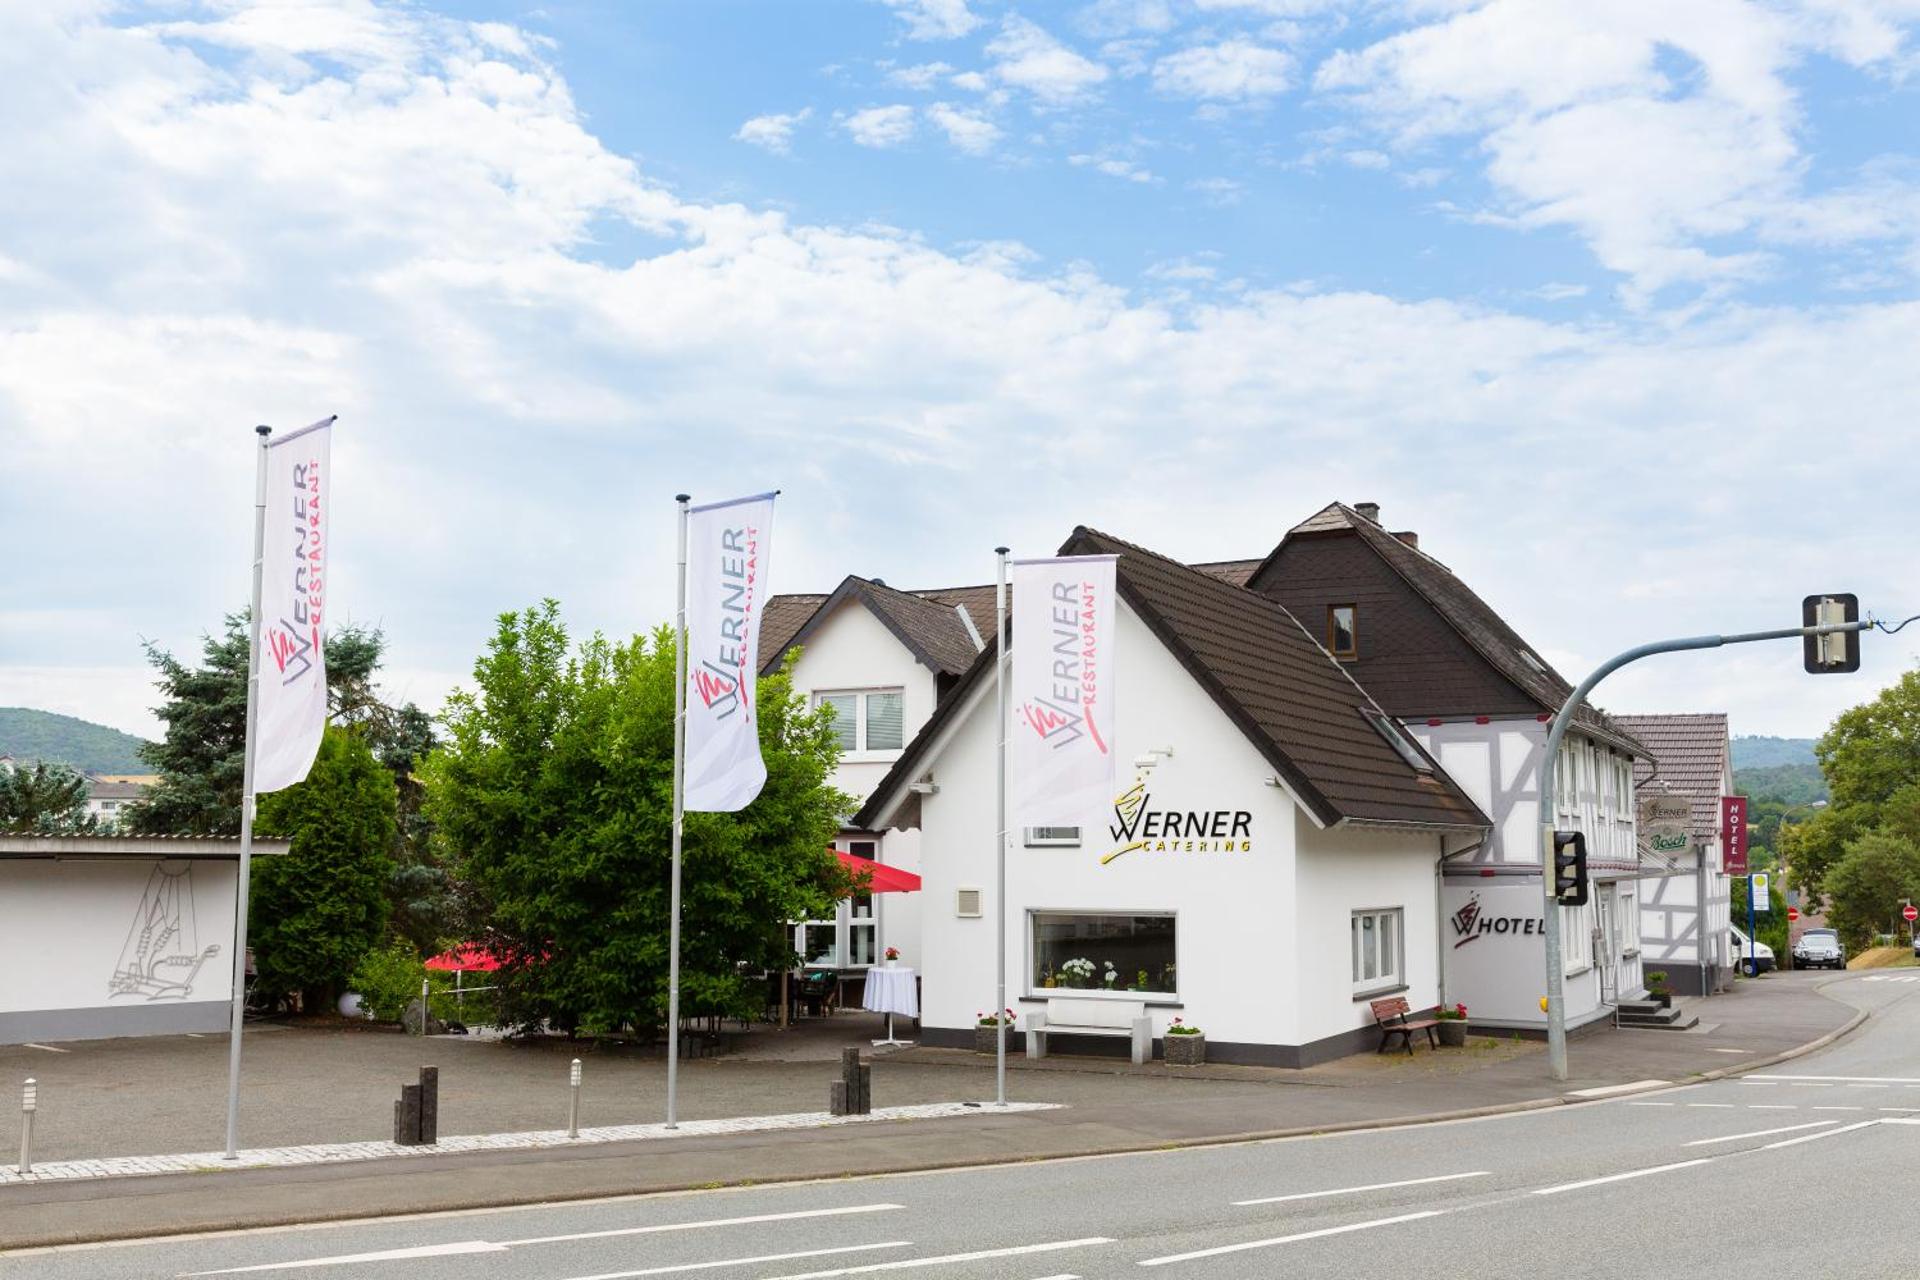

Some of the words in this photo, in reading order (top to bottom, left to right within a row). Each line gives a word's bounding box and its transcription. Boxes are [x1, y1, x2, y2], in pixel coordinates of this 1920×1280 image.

[279, 462, 313, 687] WERNER
[308, 459, 323, 624] RESTAURANT
[739, 527, 758, 668] RESAURANT
[702, 528, 746, 721] WERNER
[1034, 581, 1084, 749] WERNER
[1081, 581, 1097, 705] RESTAURANT
[1109, 793, 1252, 842] WERNER
[1142, 841, 1251, 852] CATERING
[1729, 804, 1739, 855] HOTEL
